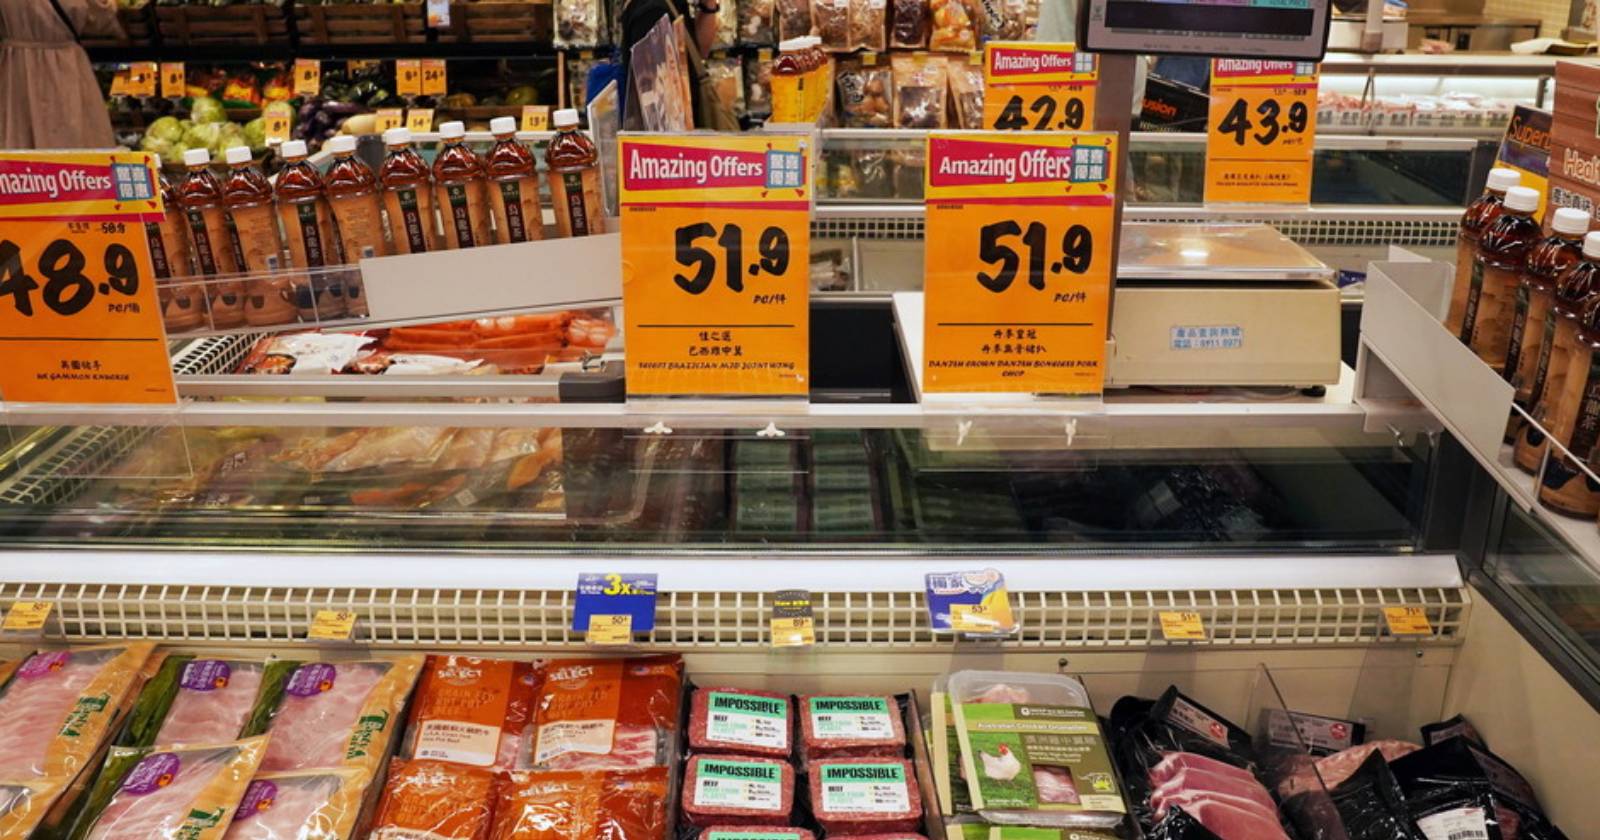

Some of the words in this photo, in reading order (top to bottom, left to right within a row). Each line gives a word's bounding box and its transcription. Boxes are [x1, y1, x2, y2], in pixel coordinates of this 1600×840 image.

[995, 51, 1040, 72] Amazing
[1041, 53, 1072, 67] Offers
[993, 95, 1085, 130] 42.9
[1142, 99, 1177, 117] usion
[1217, 98, 1308, 146] 43.9
[629, 149, 707, 185] Amazing
[710, 155, 764, 178] Offers
[939, 153, 1016, 183] Amazing
[1019, 149, 1072, 179] Offers
[0, 167, 58, 198] mazing
[59, 169, 112, 192] Offers
[673, 222, 790, 295] 51.9
[976, 219, 1093, 293] 51.9
[0, 239, 139, 317] 48.9
[714, 696, 781, 714] IMPOSSIBLE
[816, 700, 882, 711] IMPOSSIBLE
[704, 763, 776, 779] IMPOSSIBLE
[827, 767, 898, 779] IMPOSSIBLE
